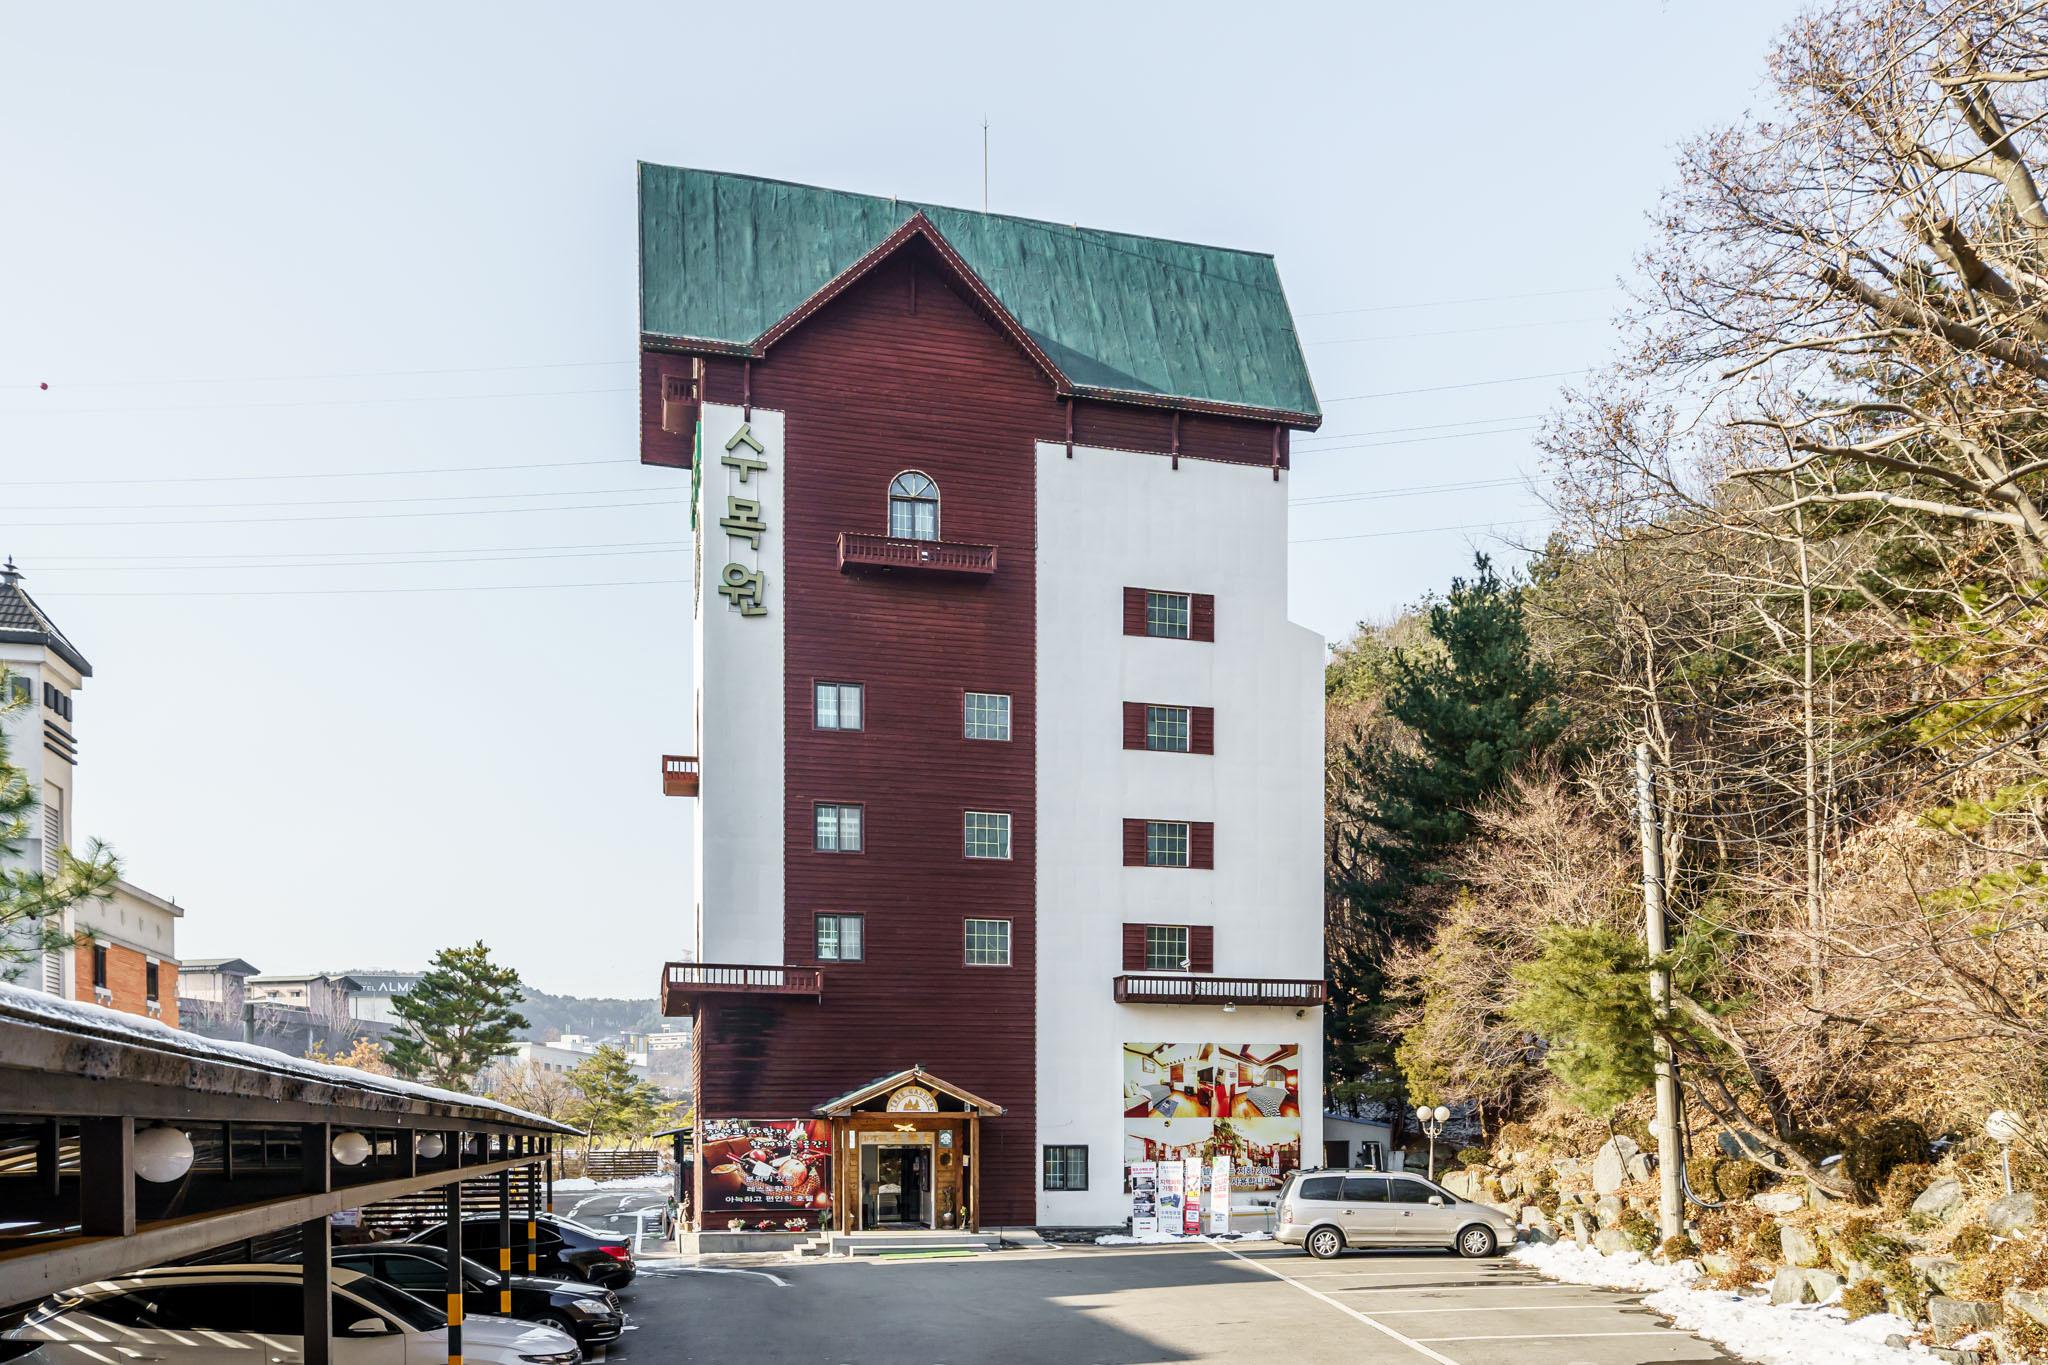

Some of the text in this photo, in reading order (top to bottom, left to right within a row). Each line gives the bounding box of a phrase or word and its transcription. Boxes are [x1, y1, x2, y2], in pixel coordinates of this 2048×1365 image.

[718, 422, 768, 617] 수목원
[747, 1126, 787, 1137] 사람이
[746, 1185, 793, 1193] 레스토랑과
[725, 1195, 814, 1203] 아늑하고 편안한 호텔
